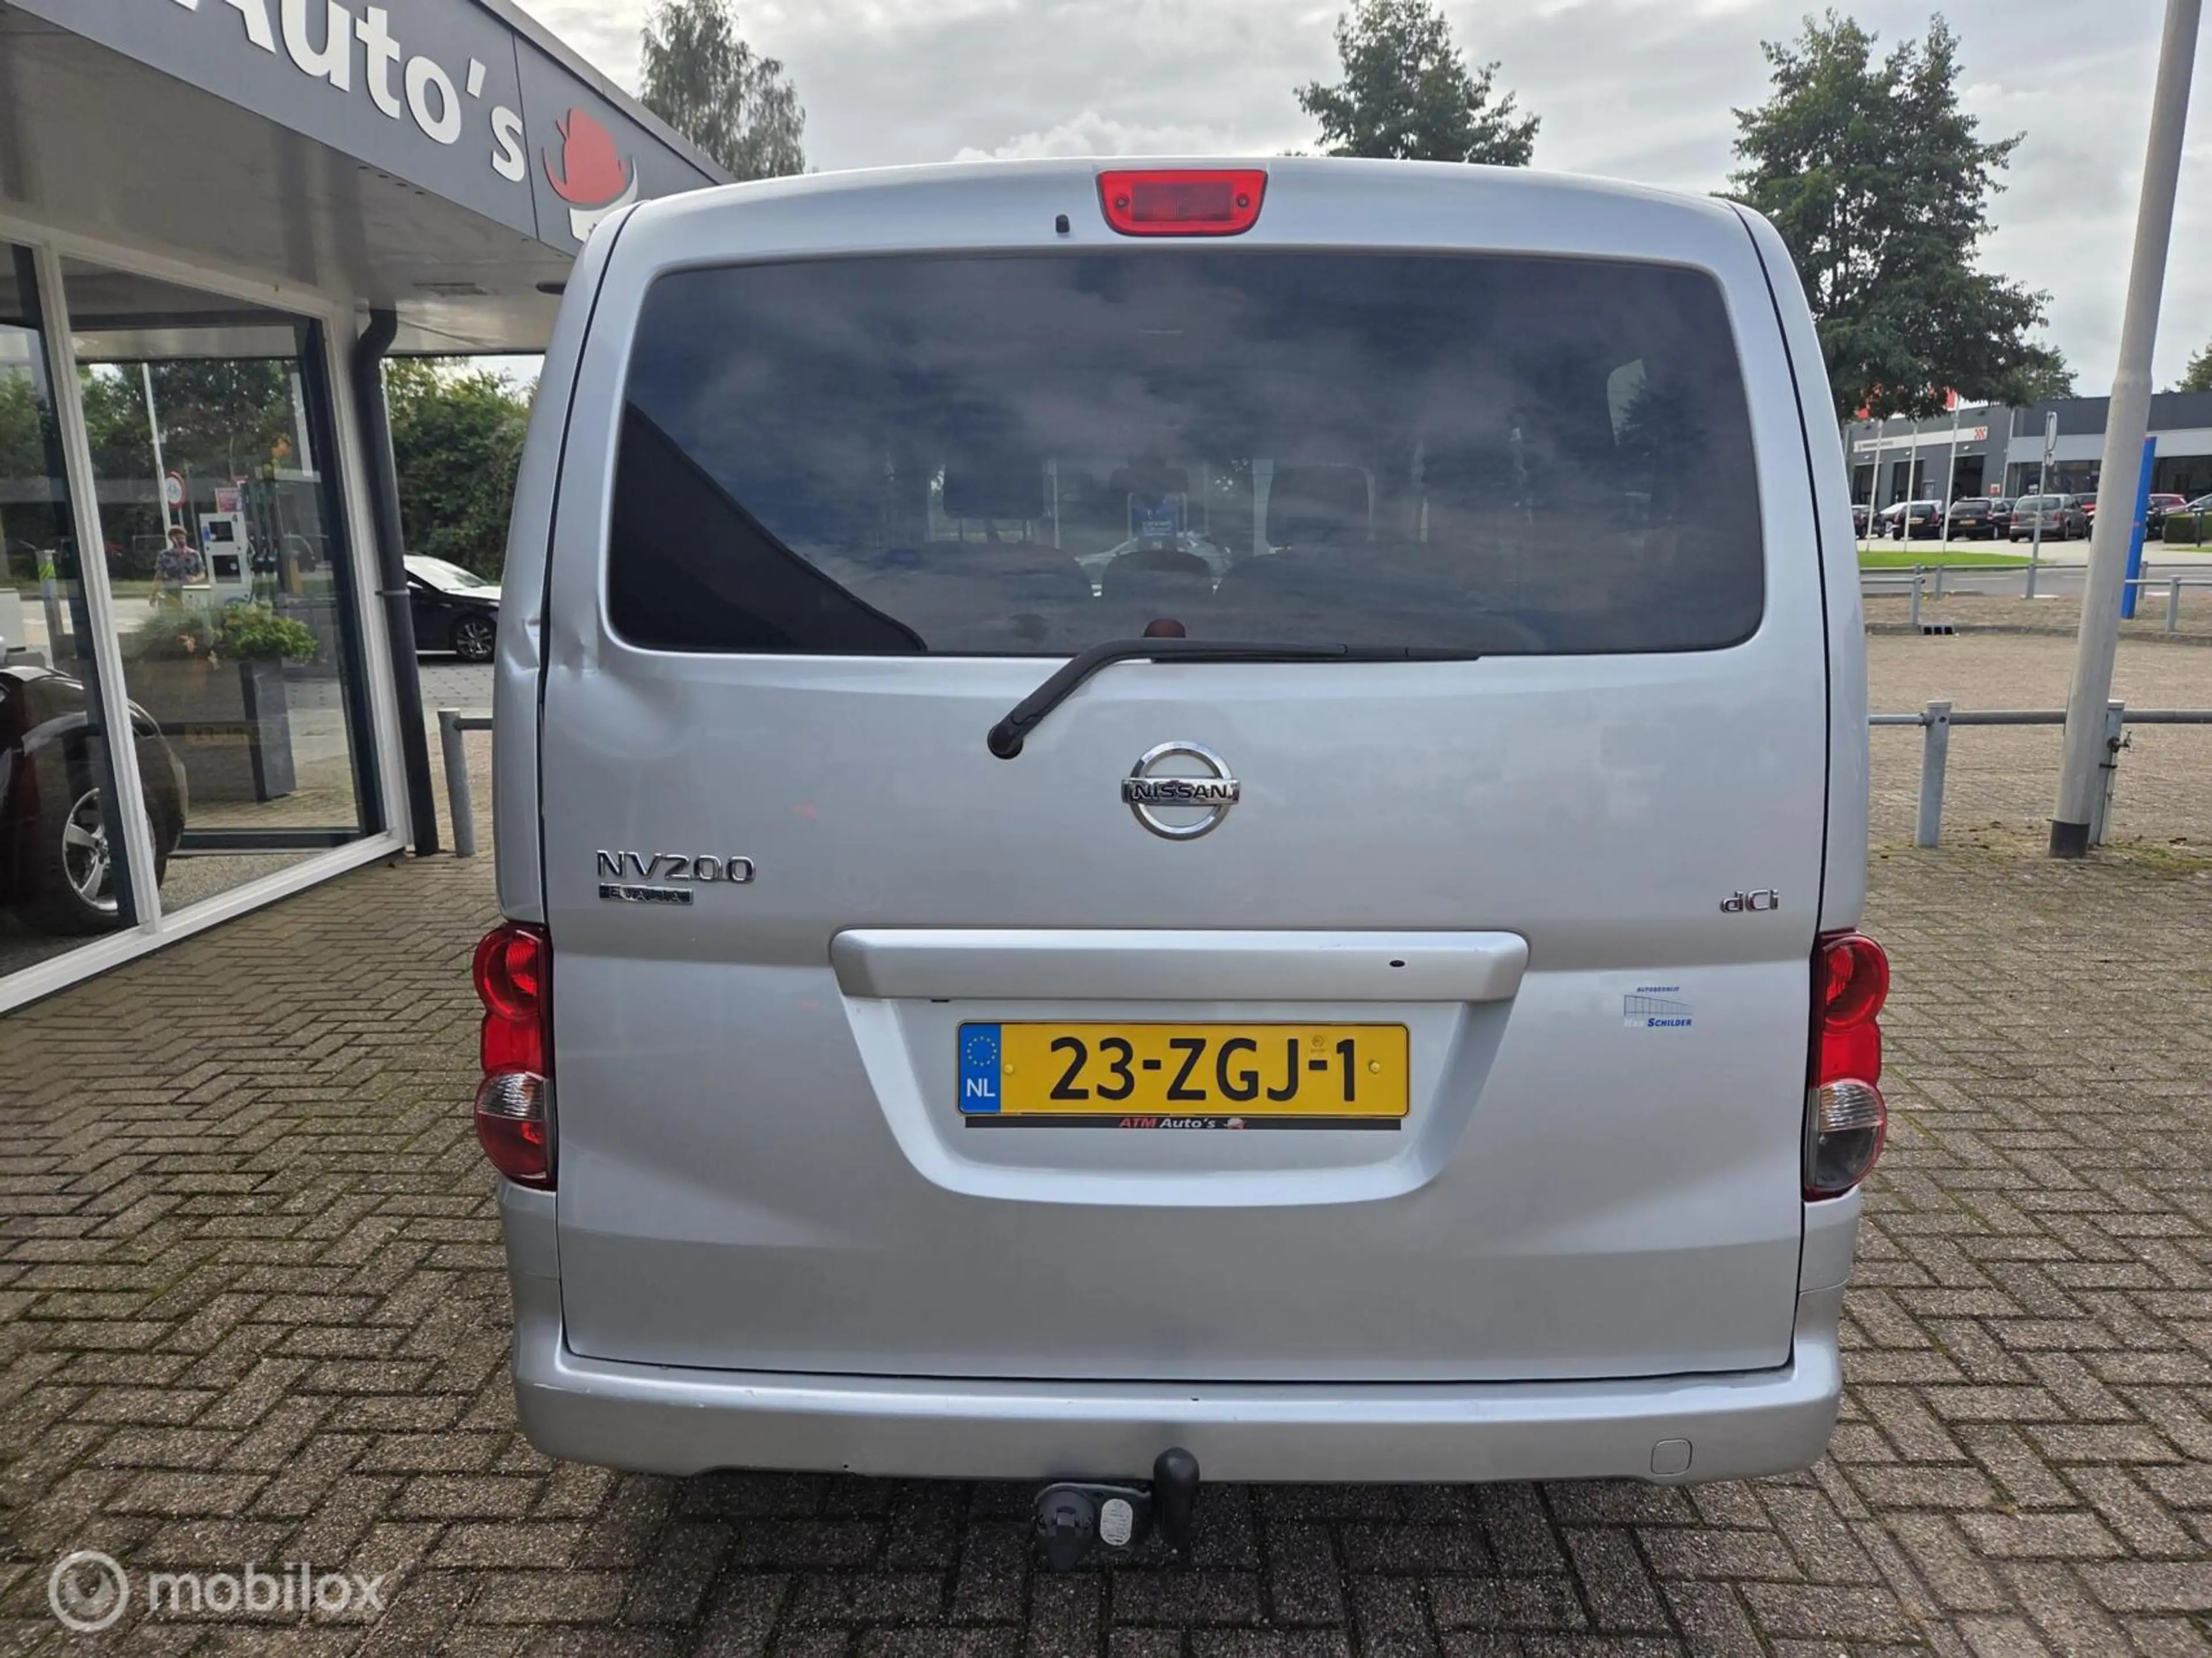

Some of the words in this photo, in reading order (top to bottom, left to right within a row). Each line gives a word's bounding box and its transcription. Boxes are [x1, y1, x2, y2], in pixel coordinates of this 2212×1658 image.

[1134, 784, 1228, 799] NISSAN
[597, 849, 755, 883] NV200
[1719, 889, 1778, 913] dCi
[1050, 1037, 1355, 1102] 23-ZGJ-1
[967, 1077, 995, 1098] NL
[1120, 1118, 1157, 1128] ATM
[1159, 1117, 1216, 1128] Auto's
